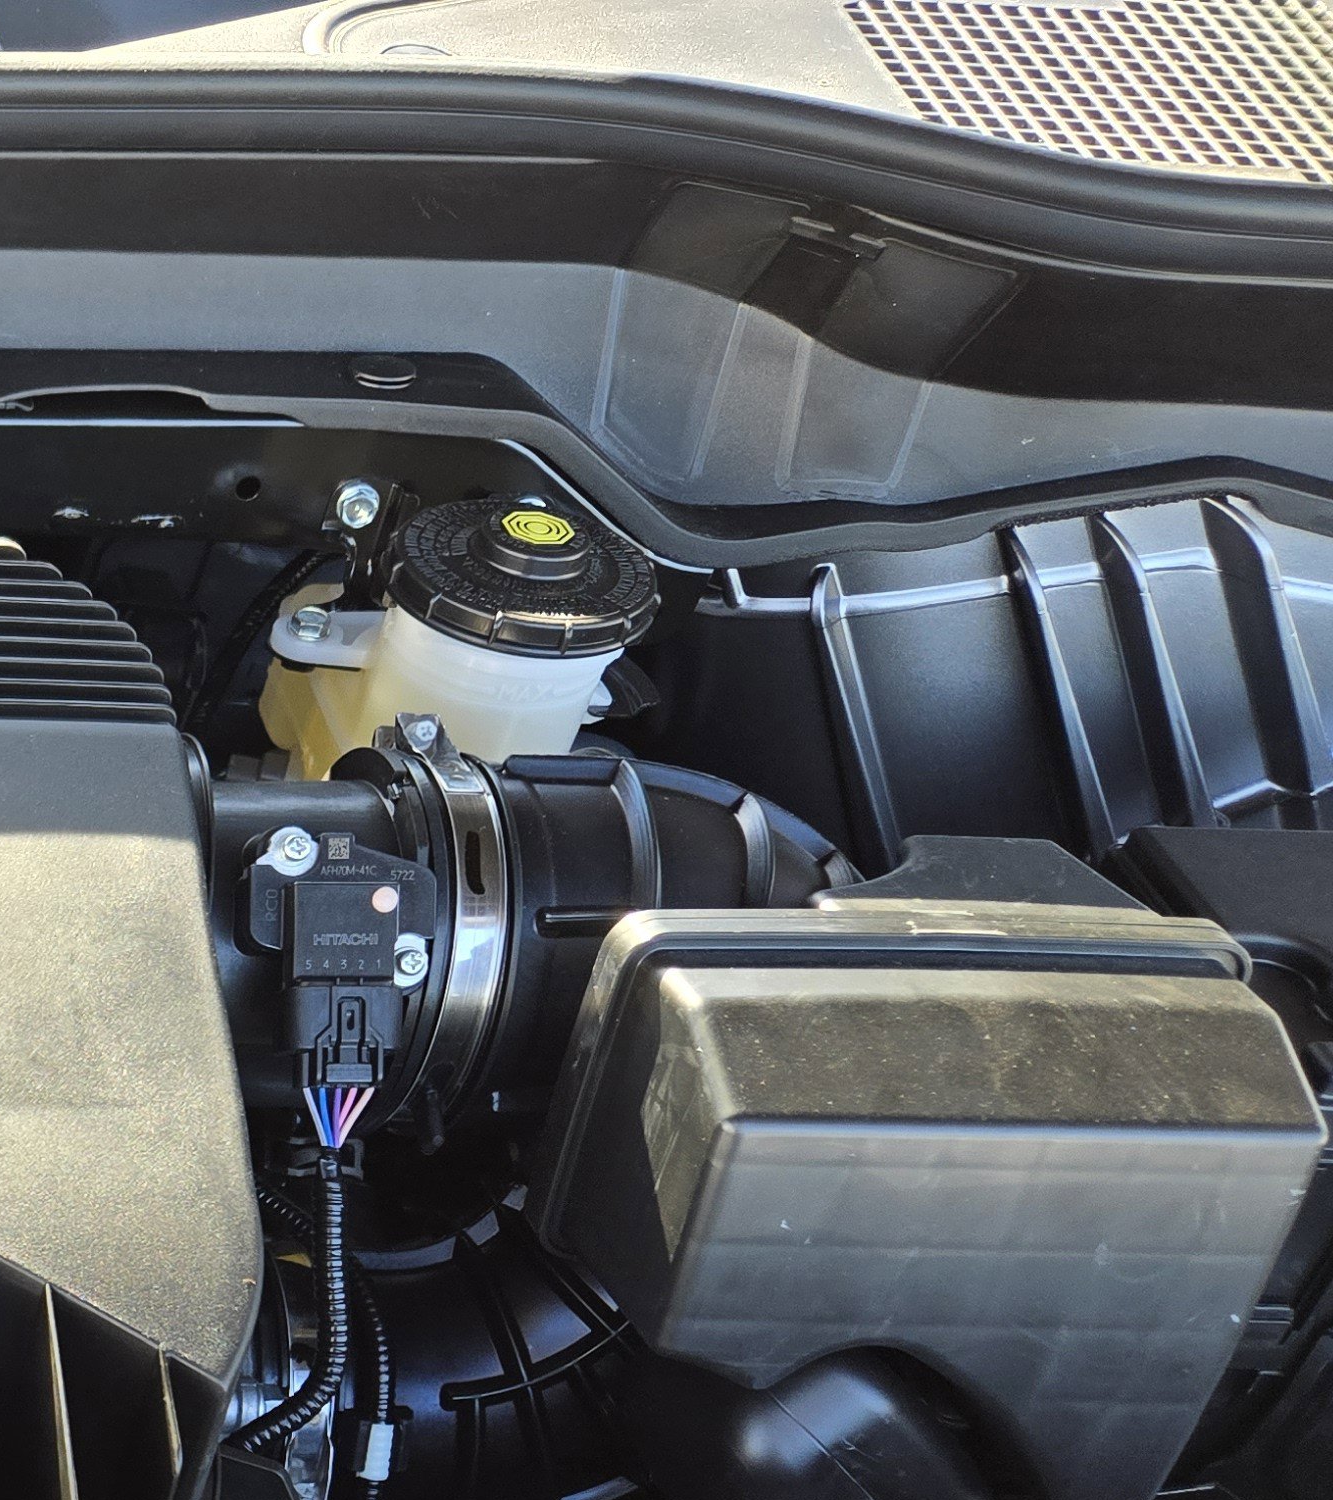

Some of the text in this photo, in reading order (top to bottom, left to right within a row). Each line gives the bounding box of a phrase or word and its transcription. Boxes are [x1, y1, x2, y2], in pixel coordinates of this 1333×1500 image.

[390, 869, 415, 881] 5722
[313, 933, 379, 946] HITACHI
[305, 958, 382, 970] 5 4 3 2 1
